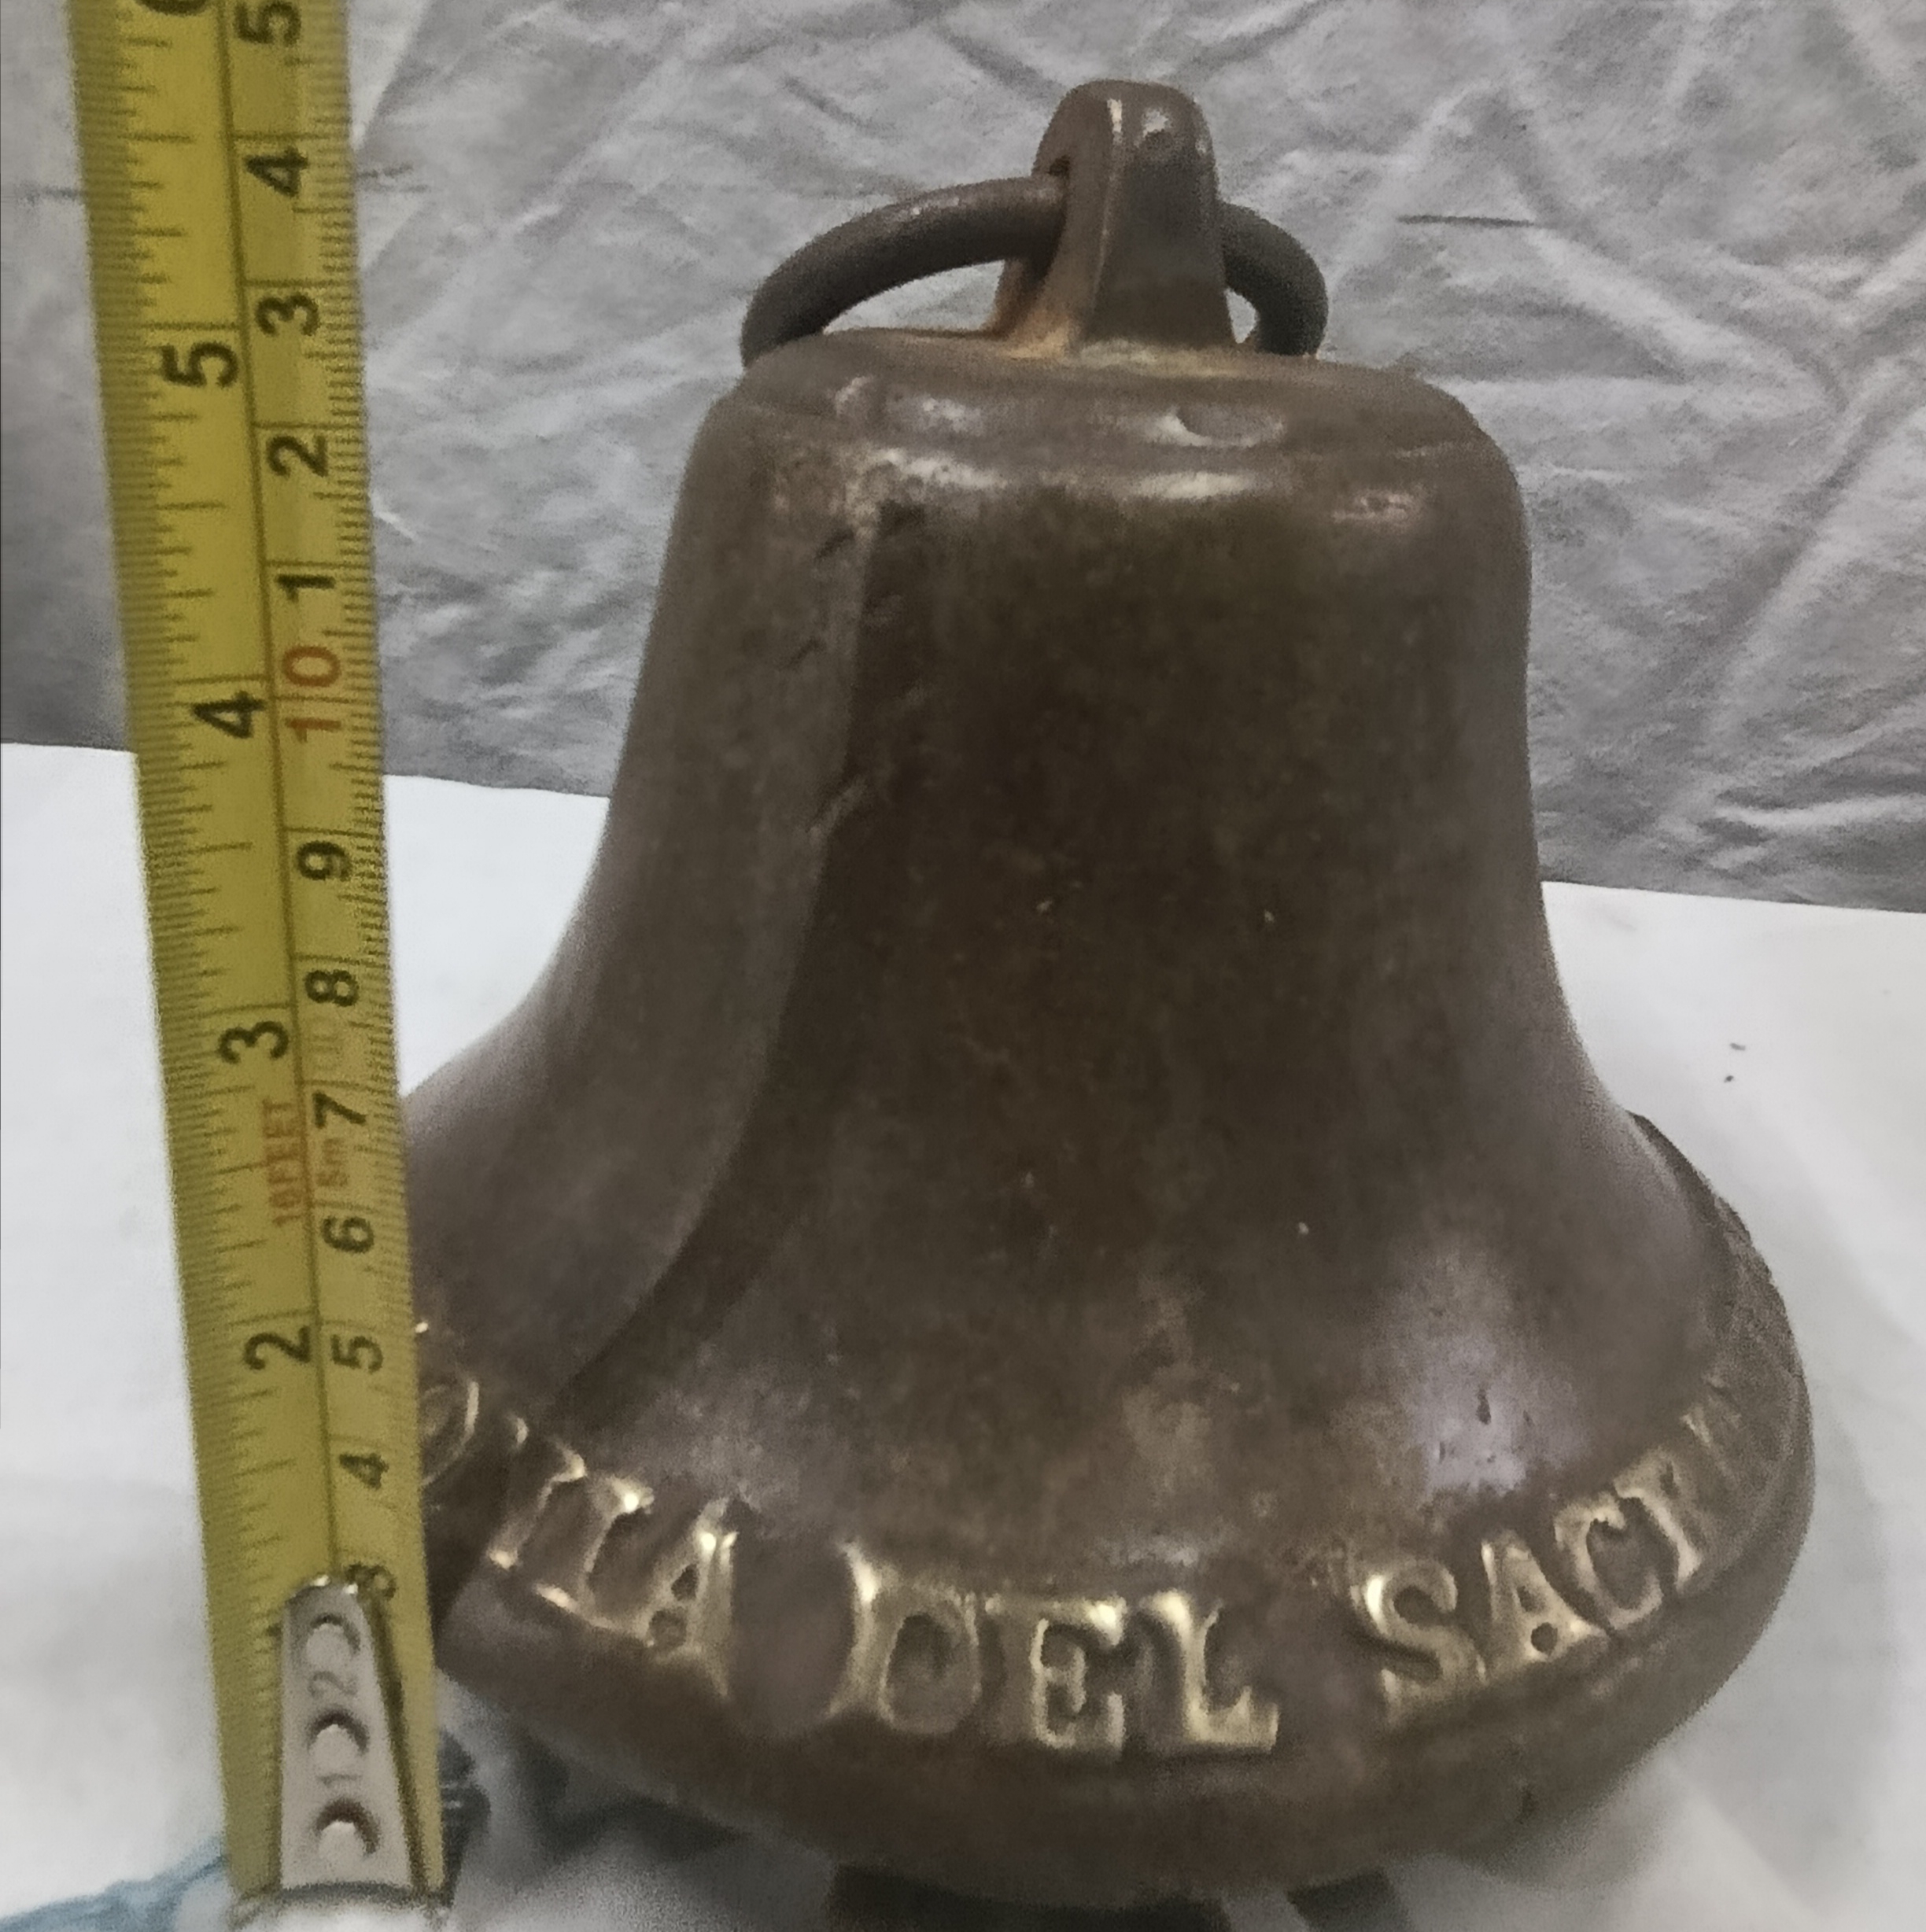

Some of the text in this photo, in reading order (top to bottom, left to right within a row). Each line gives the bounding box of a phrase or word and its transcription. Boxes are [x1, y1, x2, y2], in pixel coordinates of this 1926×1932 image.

[245, 144, 308, 197] 4
[255, 293, 319, 337] 3
[159, 342, 237, 387] 5
[266, 436, 328, 477] 2
[275, 573, 335, 603] 1
[190, 691, 266, 739] 4
[281, 646, 341, 743] 10
[296, 841, 351, 881] 9
[305, 970, 360, 1007] 8
[218, 1021, 290, 1064] 3
[313, 1092, 366, 1128] 7
[320, 1216, 374, 1253] 6
[243, 1326, 312, 1371] 2
[330, 1335, 384, 1373] 5
[338, 1451, 389, 1488] 4
[823, 1538, 1281, 1762] DEL
